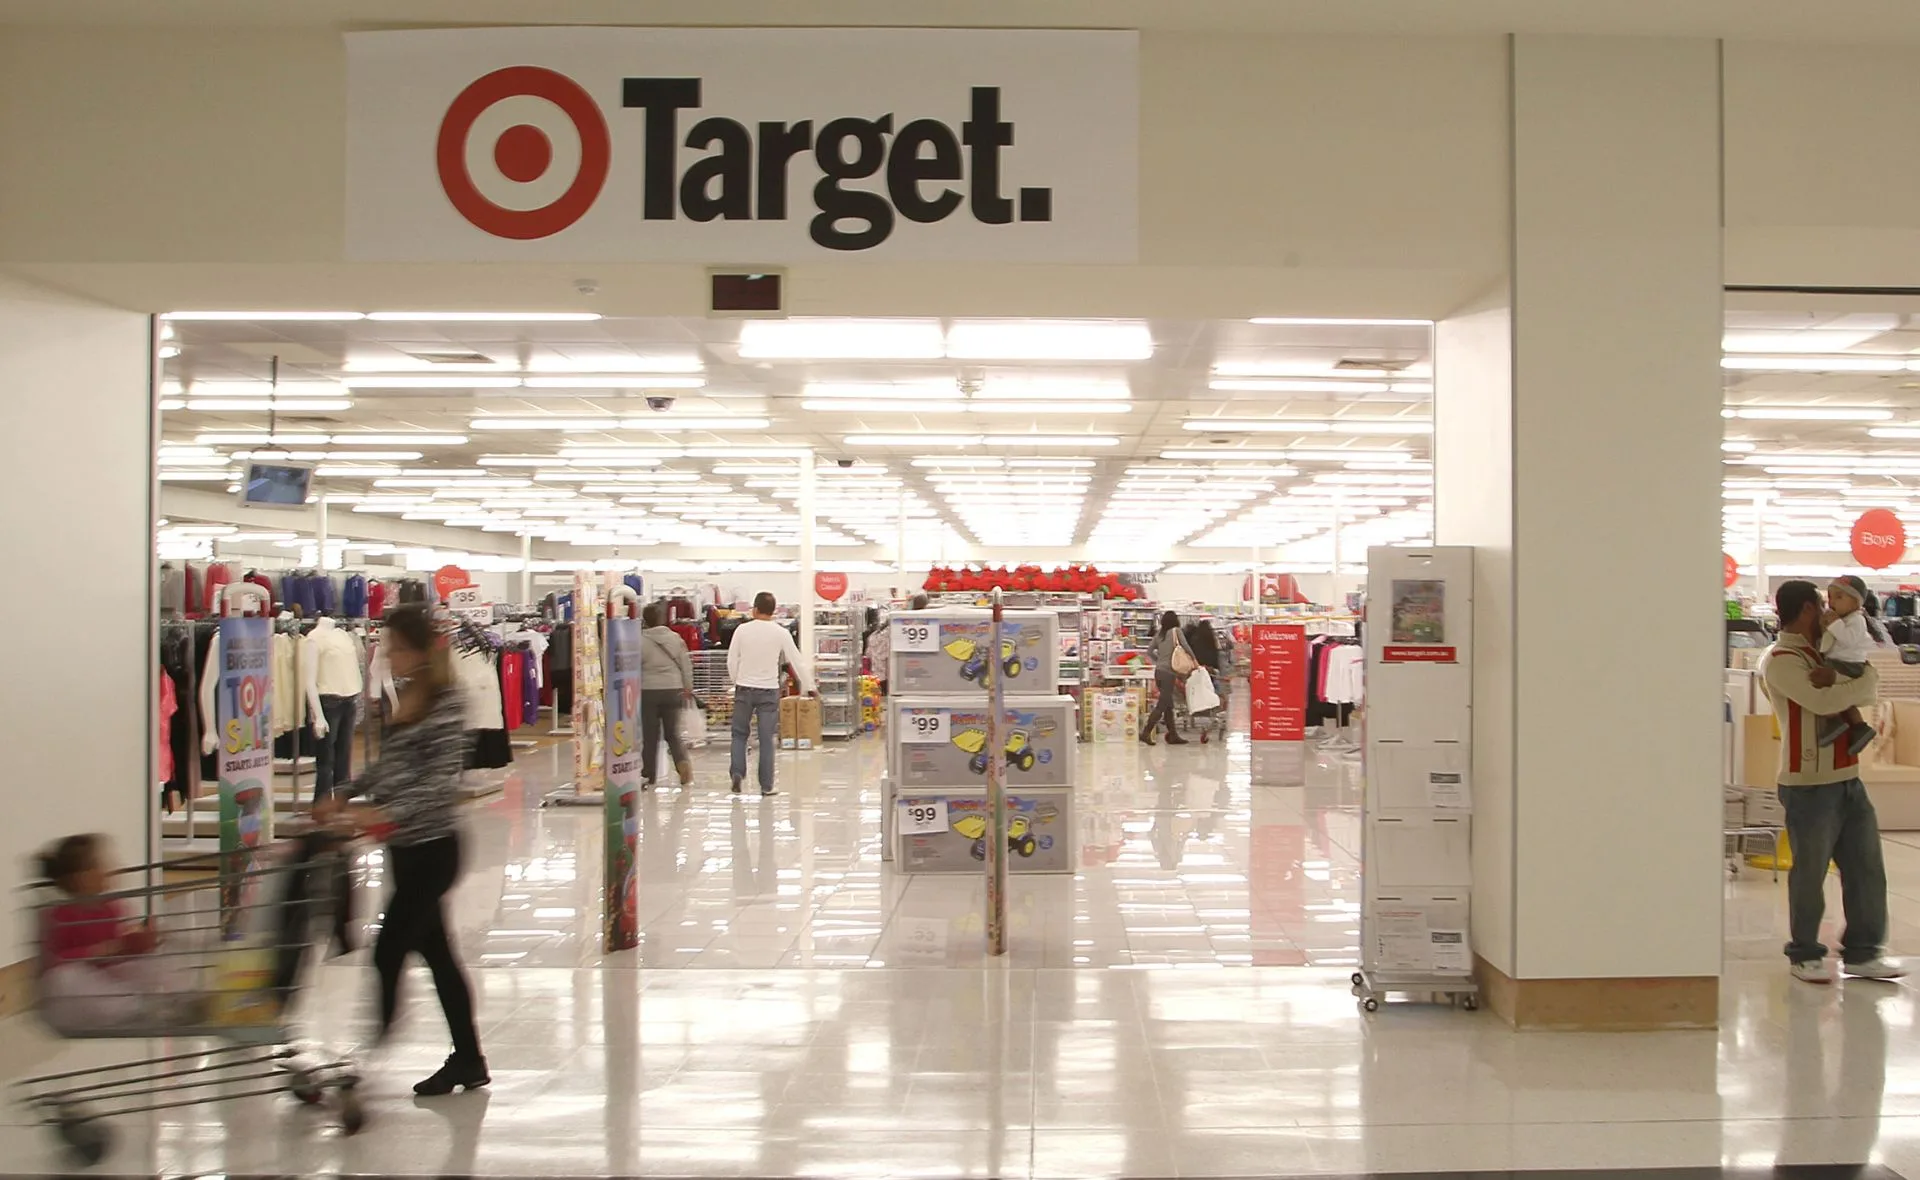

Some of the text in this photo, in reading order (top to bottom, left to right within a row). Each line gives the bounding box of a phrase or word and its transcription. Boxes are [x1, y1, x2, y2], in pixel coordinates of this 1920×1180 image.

[1861, 531, 1897, 548] Boys
[902, 627, 929, 641] $99
[226, 674, 272, 719] TOY
[911, 716, 940, 731] $99
[225, 715, 269, 754] SALE
[908, 807, 936, 822] $99
